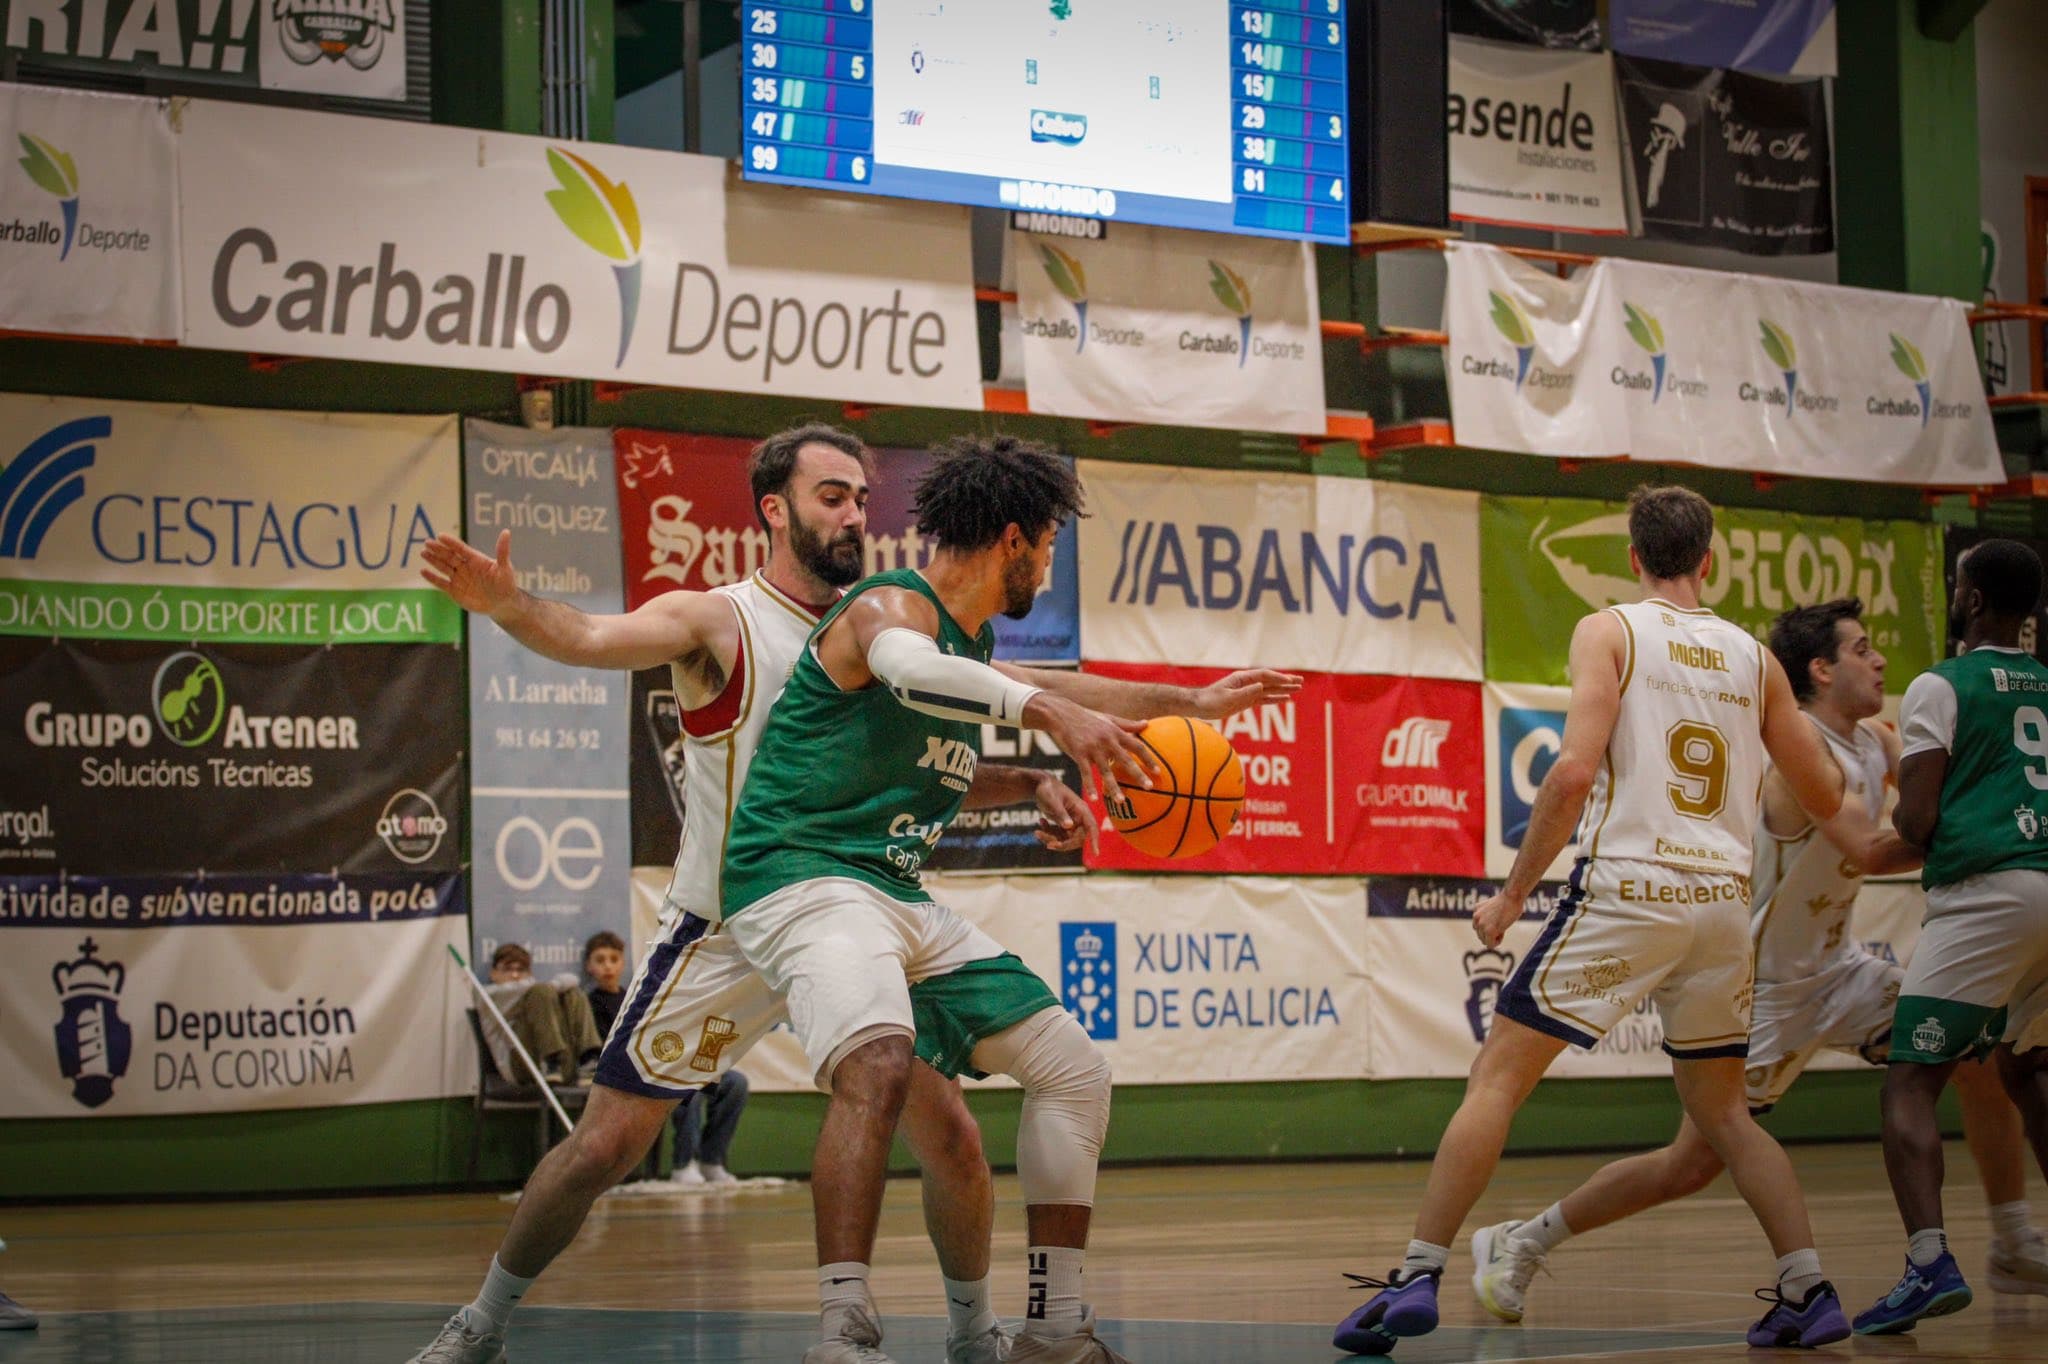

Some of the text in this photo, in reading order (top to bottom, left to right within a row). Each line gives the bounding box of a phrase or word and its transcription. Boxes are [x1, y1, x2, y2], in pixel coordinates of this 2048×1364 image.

[751, 9, 777, 34] 25
[1241, 10, 1340, 45] 13 3
[752, 43, 865, 79] 30 5
[1242, 42, 1264, 65] 14
[752, 77, 777, 102] 35
[1242, 73, 1264, 98] 15
[752, 111, 777, 136] 47
[1242, 104, 1342, 138] 29 3
[752, 145, 866, 181] 99 6
[1242, 136, 1265, 161] 38
[1516, 147, 1599, 173] Instalaciones
[1019, 180, 1116, 217] MONDO
[1242, 168, 1343, 202] 81 4
[78, 222, 151, 252] Deporte
[1029, 212, 1101, 239] MONDO
[211, 227, 946, 382] Carballo Deporte
[1179, 331, 1305, 361] Carballo Deporte
[474, 492, 609, 535] Enríquez
[92, 494, 438, 571] GESTAGUA
[142, 591, 172, 632] Ó
[180, 600, 320, 635] DEPORTE
[328, 600, 428, 635] LOCAL
[1667, 640, 1730, 673] MIGUEL
[508, 675, 608, 706] Laracha
[2013, 705, 2048, 790] 9
[81, 757, 313, 788] Solucións Técnicas
[1666, 719, 1730, 821] 9
[0, 804, 55, 845] rgal.
[1253, 820, 1302, 837] FERROL
[140, 883, 361, 922] subvencionada
[370, 882, 438, 921] pola
[1619, 879, 1736, 905] E.Leclerc
[1134, 933, 1259, 973] XUNTA
[1134, 987, 1340, 1028] DE GALICIA
[155, 998, 356, 1052] Deputación
[155, 1042, 355, 1092] DA CORUÑA
